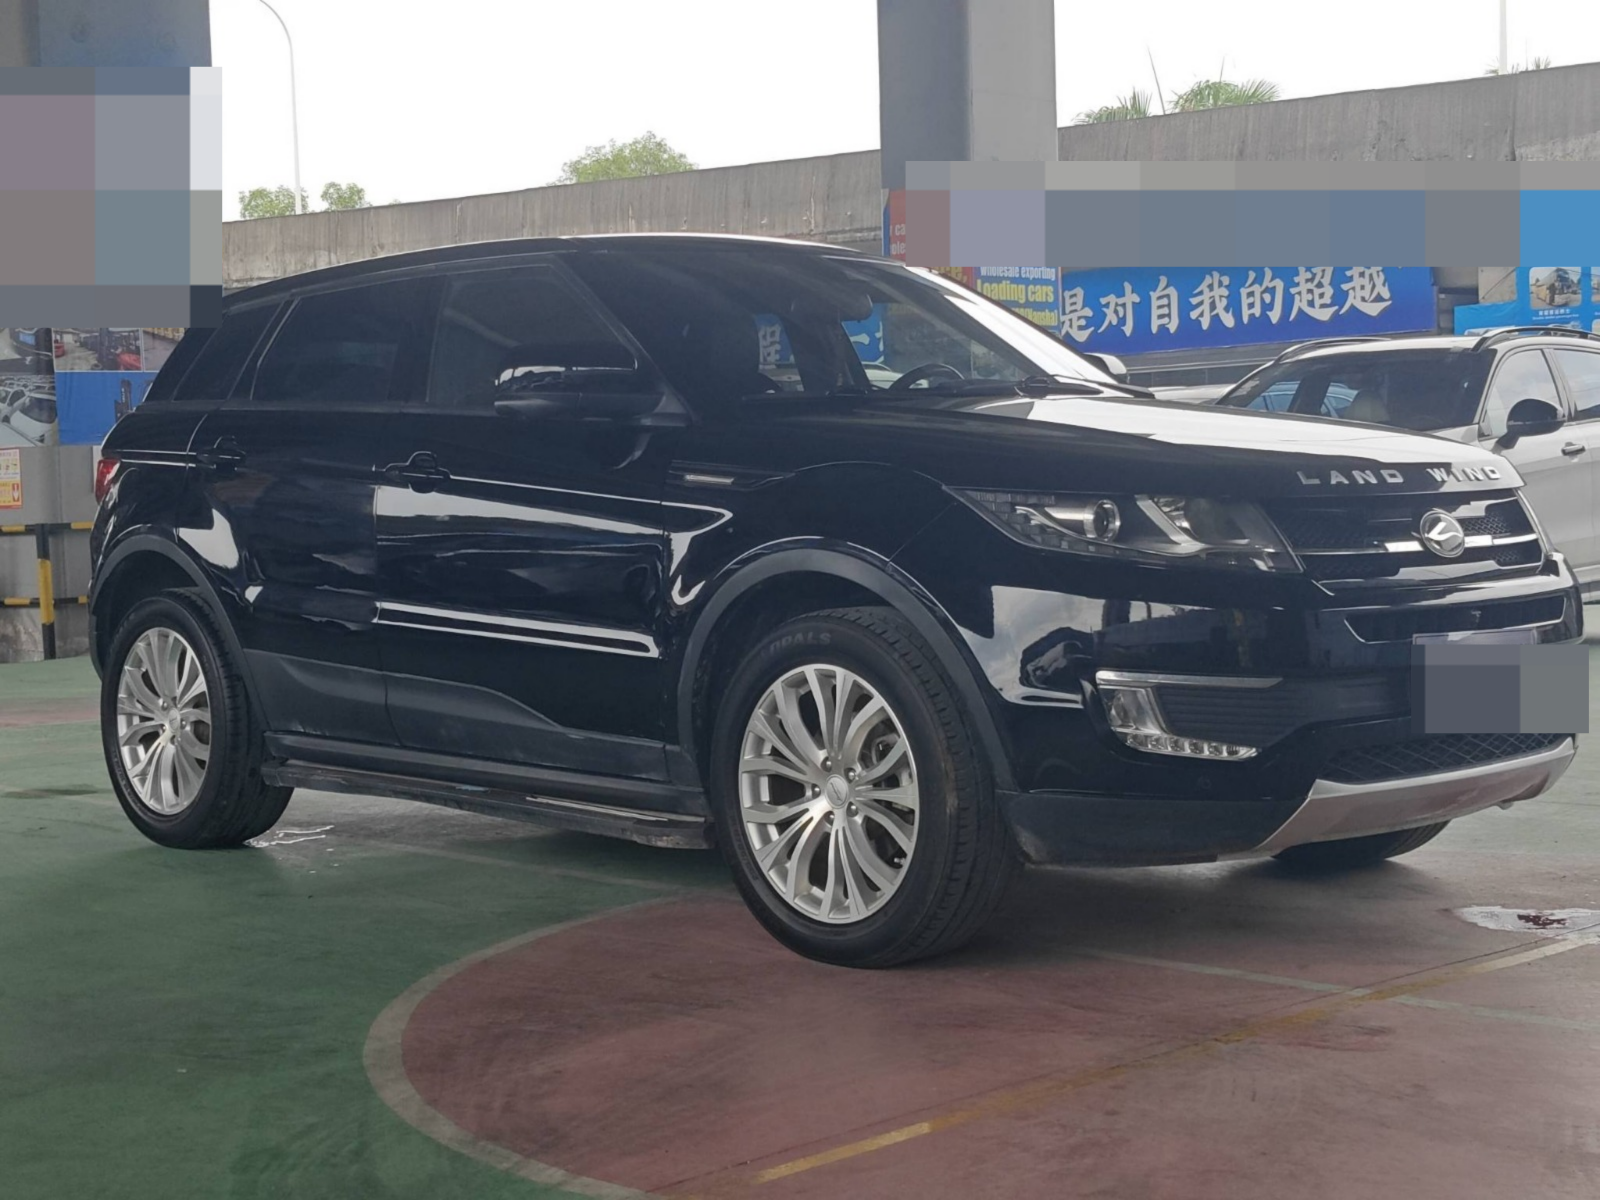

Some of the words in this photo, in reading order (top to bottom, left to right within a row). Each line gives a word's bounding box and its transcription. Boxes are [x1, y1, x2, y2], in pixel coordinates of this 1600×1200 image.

[1027, 284, 1055, 303] cars
[1061, 266, 1393, 343] 是对自我的超越
[1296, 469, 1404, 485] LAND
[1426, 466, 1501, 483] WIND
